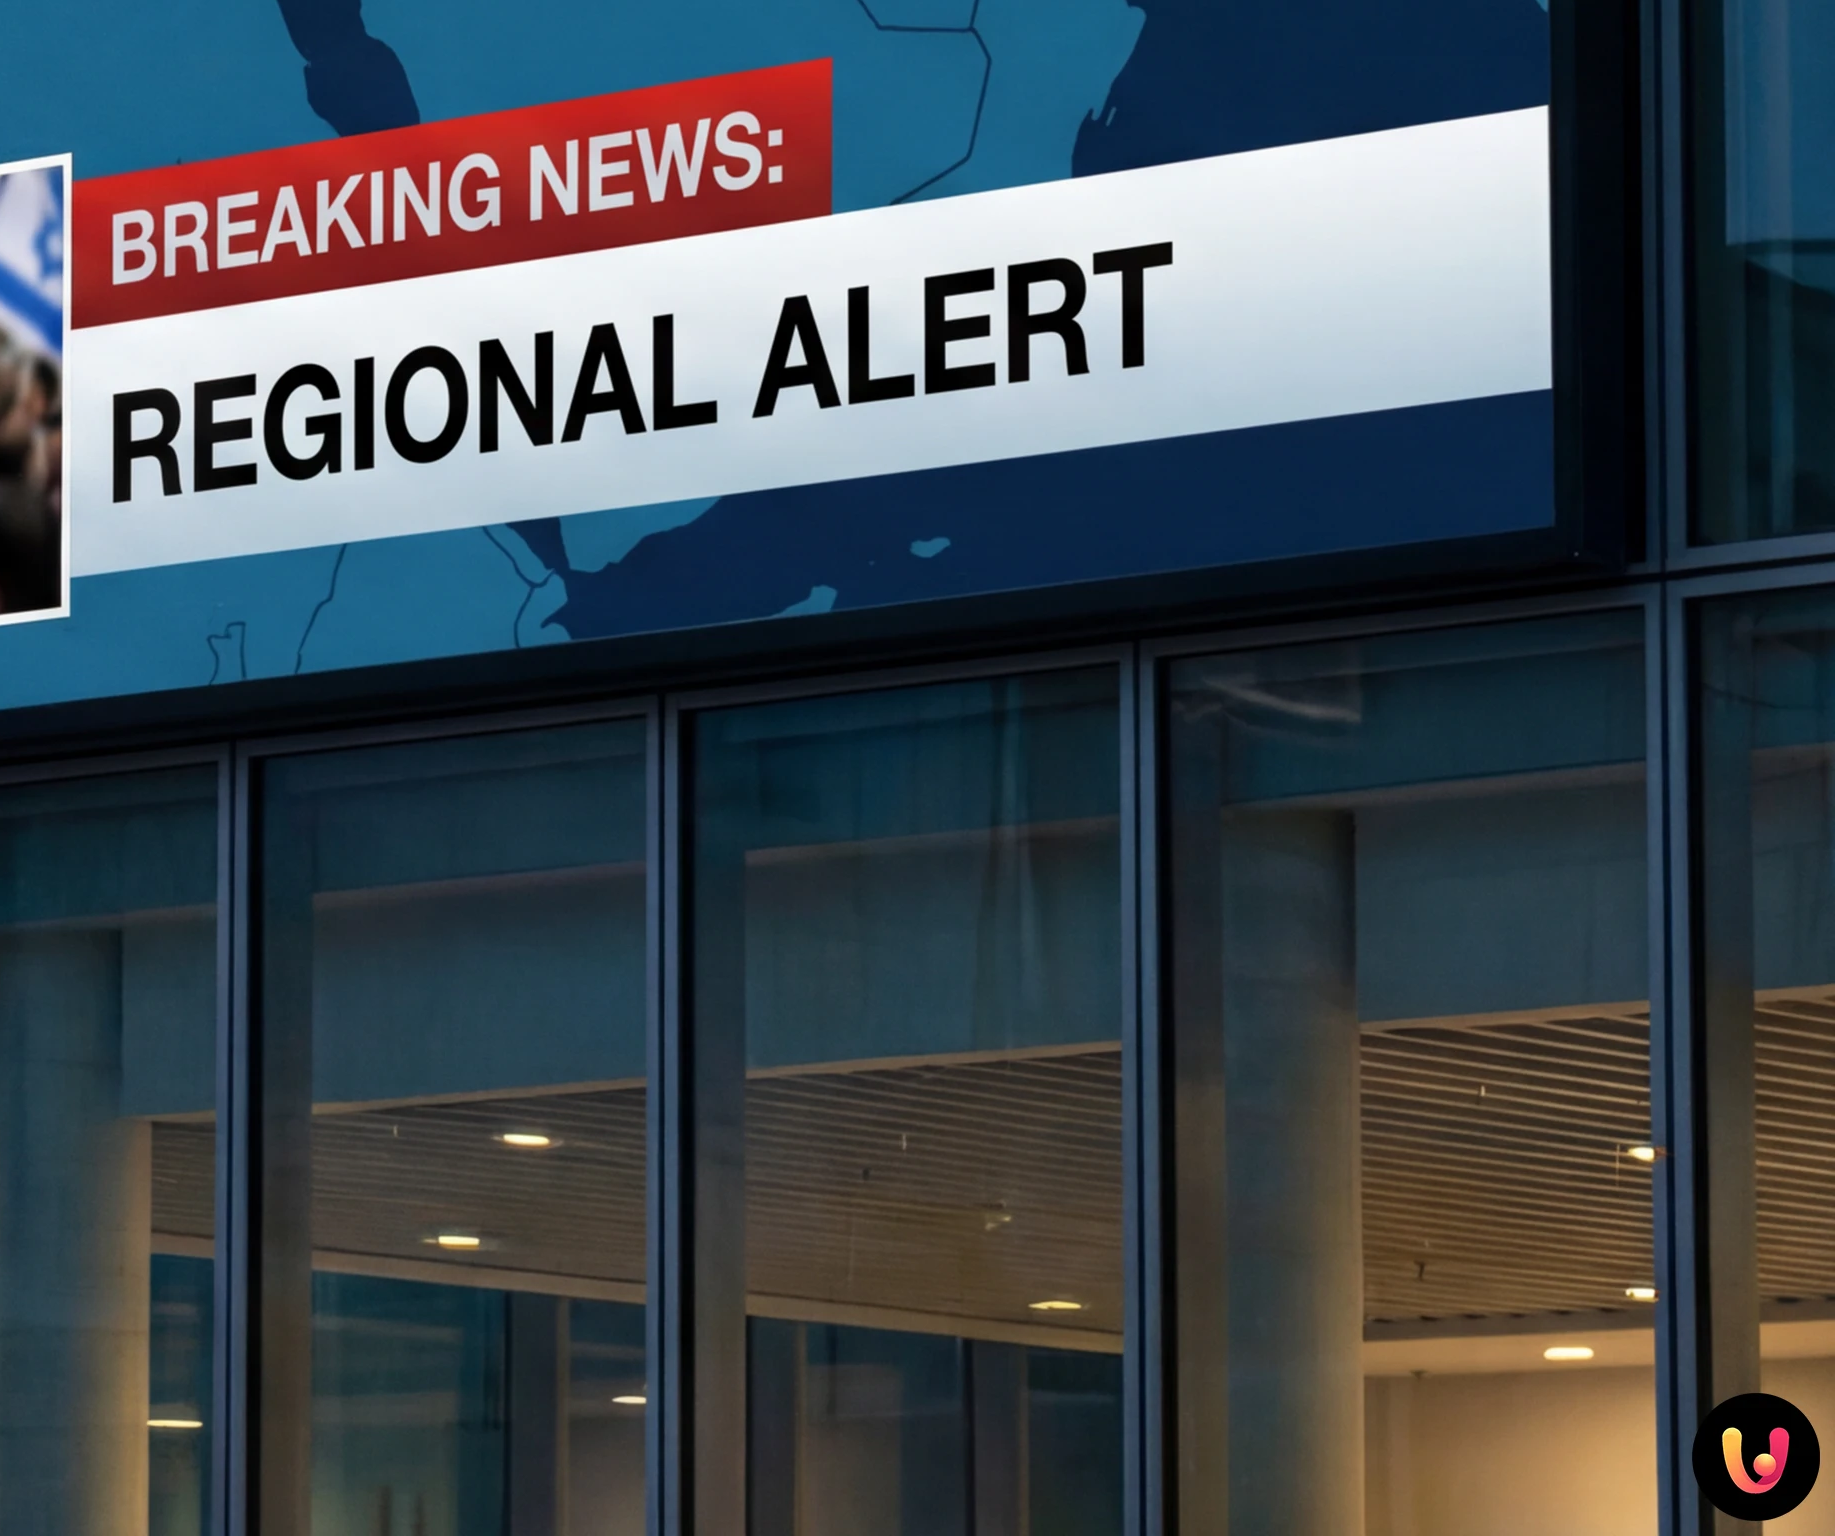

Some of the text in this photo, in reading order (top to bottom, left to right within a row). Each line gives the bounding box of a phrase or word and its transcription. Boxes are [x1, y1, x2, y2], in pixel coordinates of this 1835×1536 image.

[112, 110, 783, 286] BREAKING NEWS:
[112, 241, 1173, 504] REGIONAL ALERT
